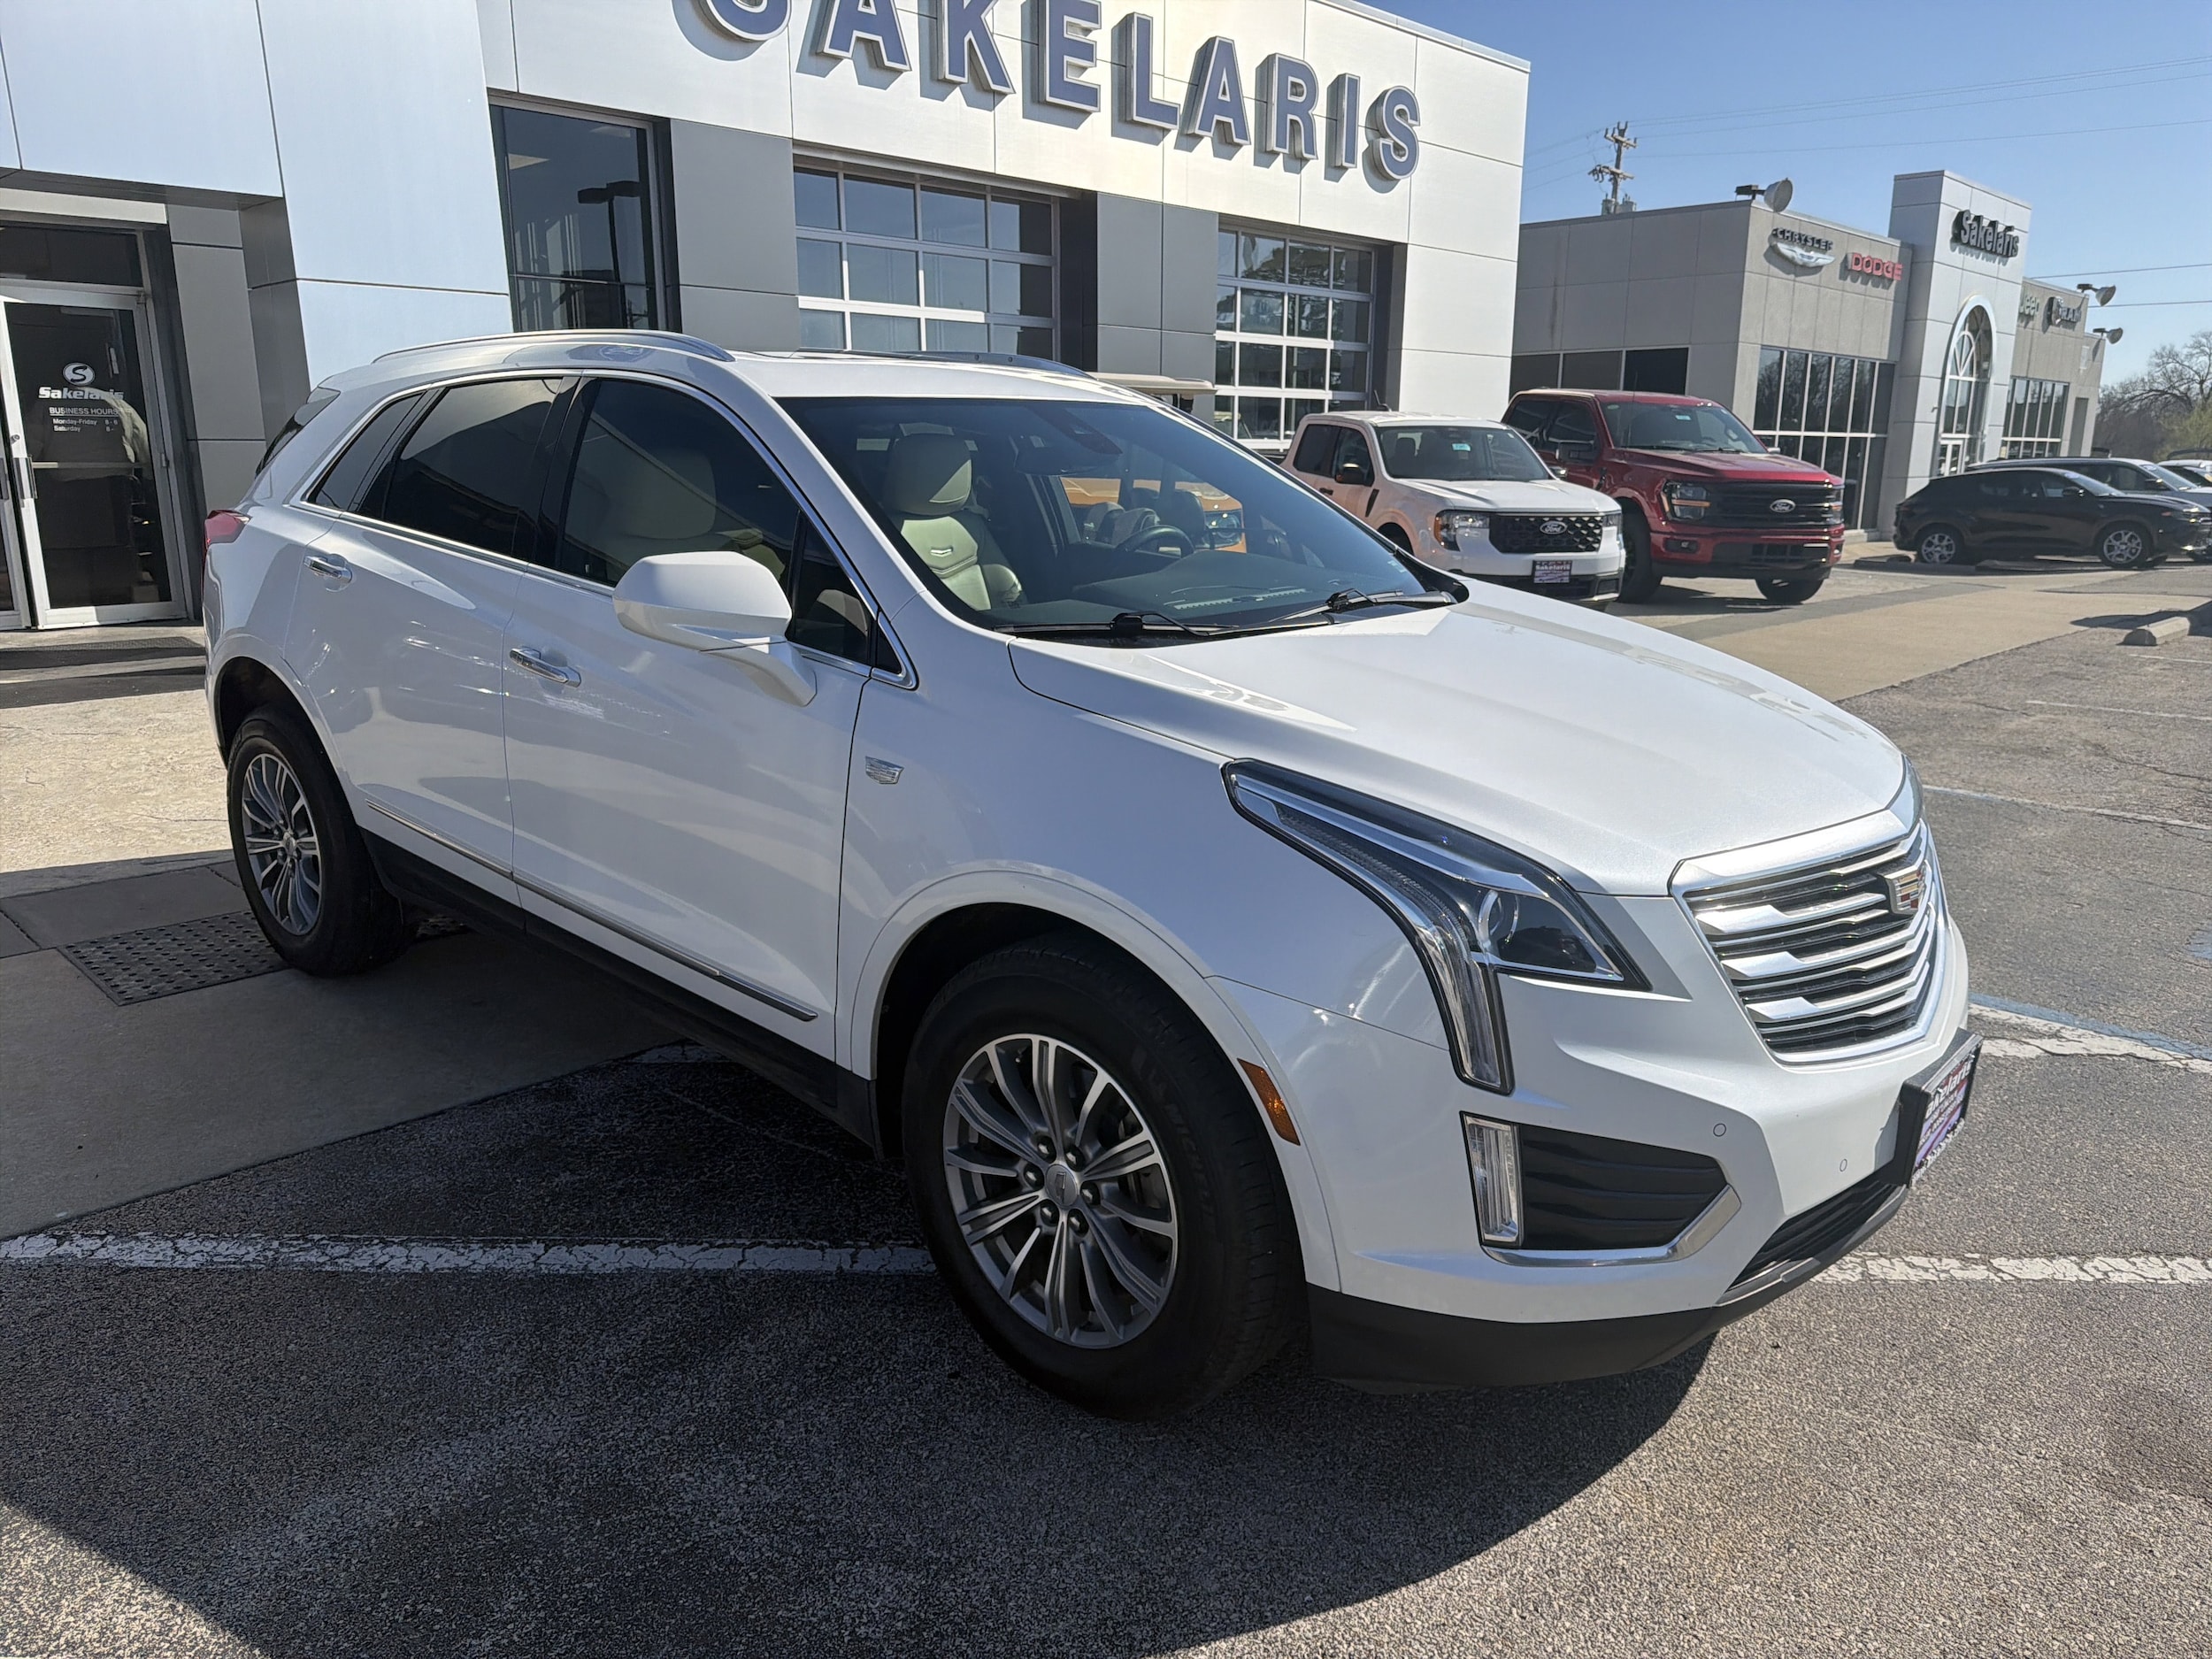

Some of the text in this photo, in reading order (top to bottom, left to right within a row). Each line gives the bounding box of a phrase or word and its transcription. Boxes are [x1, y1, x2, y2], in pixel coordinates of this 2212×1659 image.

[1776, 227, 1834, 250] CHRYSLER
[1960, 211, 2020, 257] Sakelaris
[1851, 252, 1903, 280] DODGE
[1545, 524, 1562, 533] Ford
